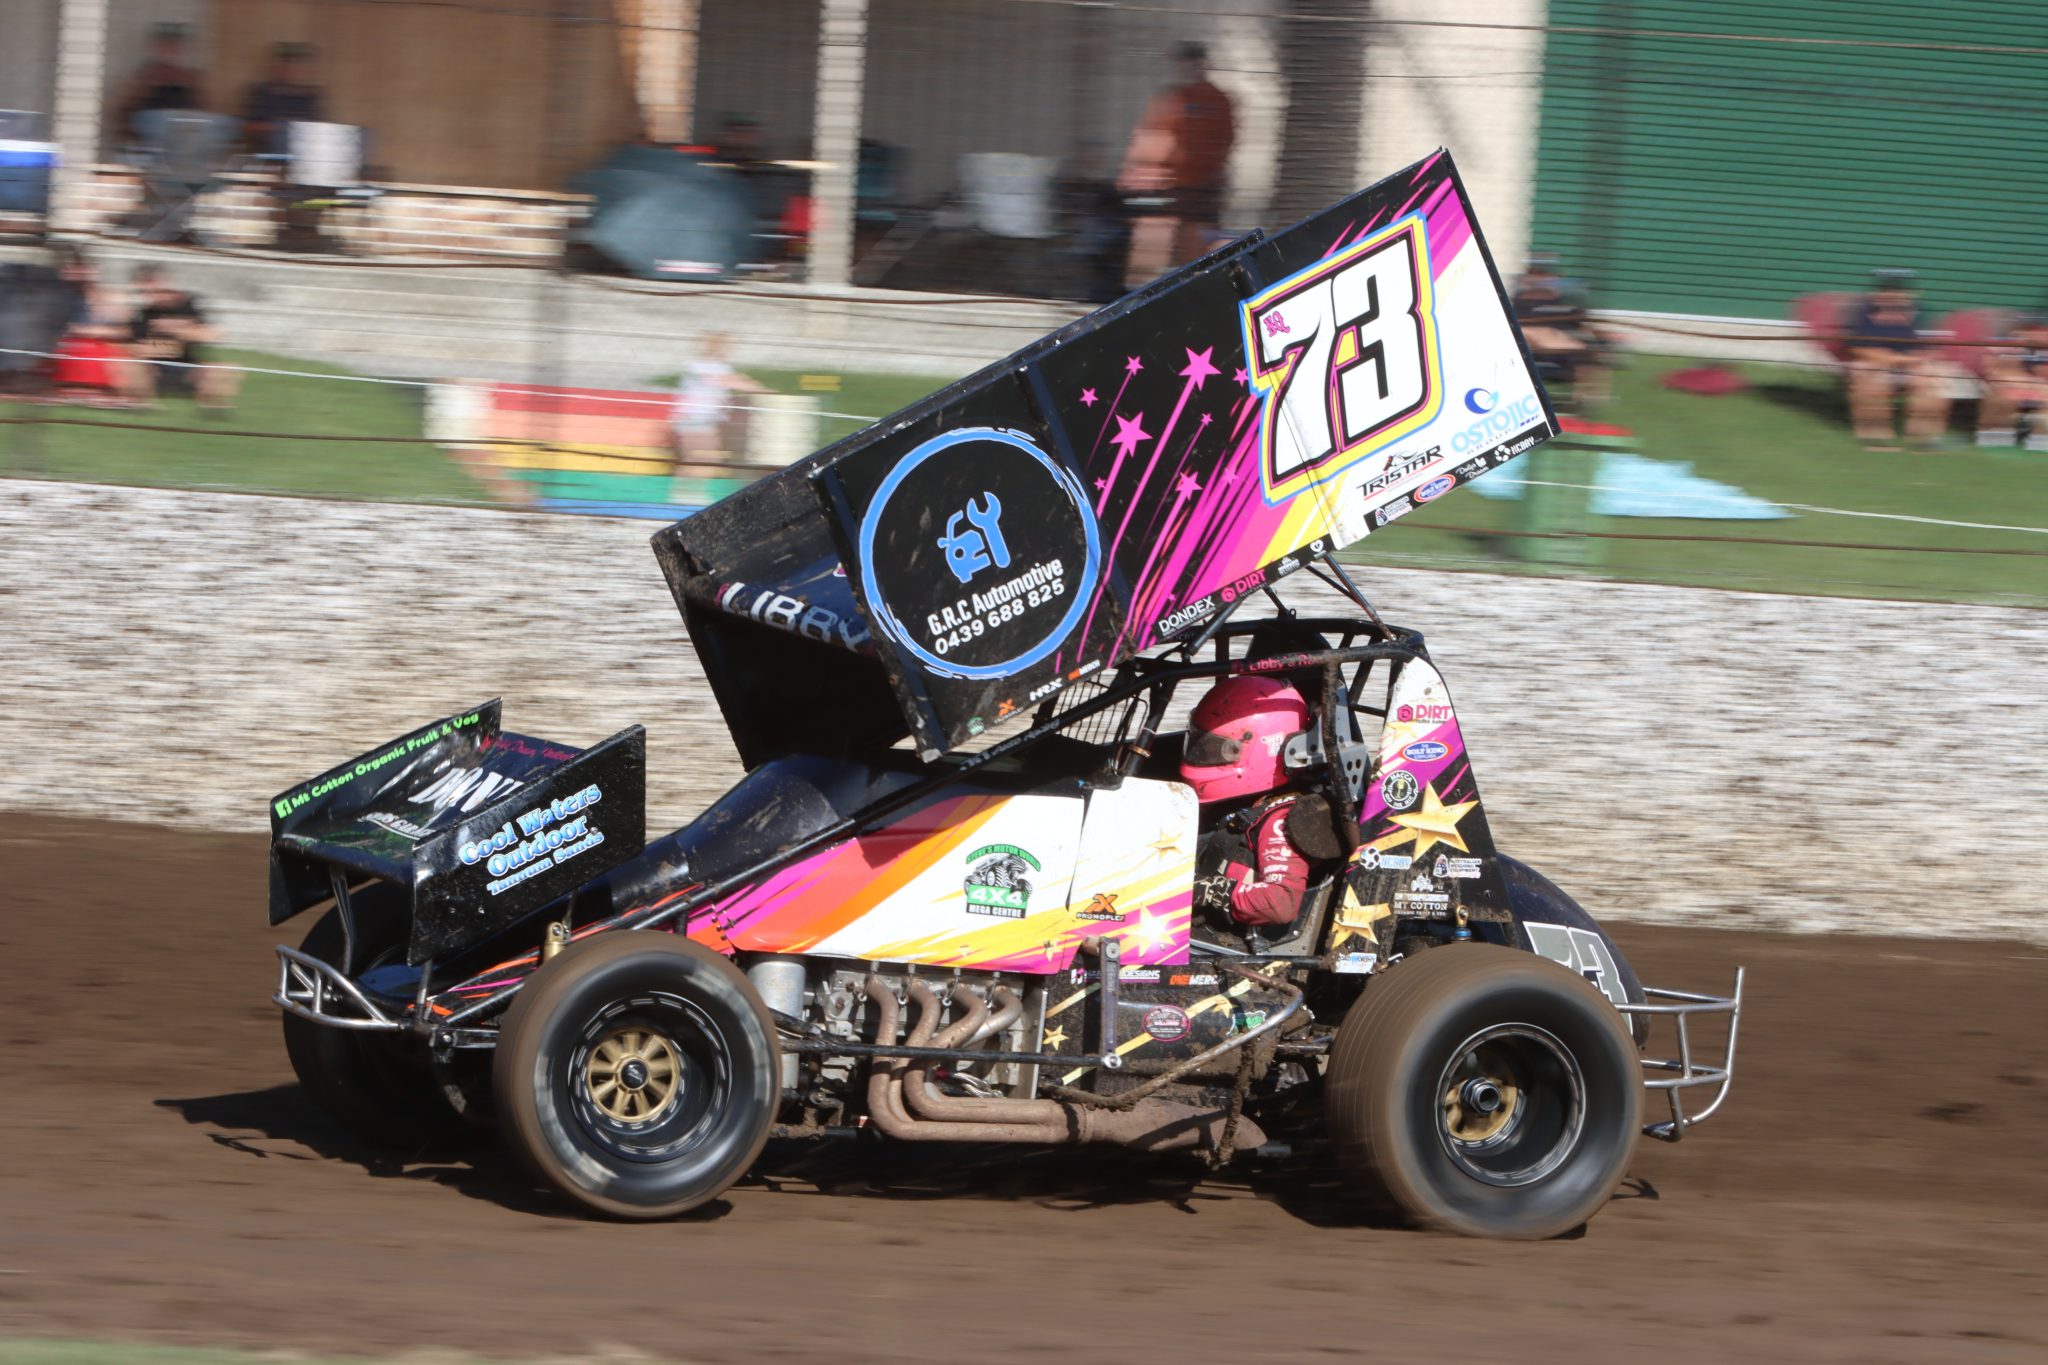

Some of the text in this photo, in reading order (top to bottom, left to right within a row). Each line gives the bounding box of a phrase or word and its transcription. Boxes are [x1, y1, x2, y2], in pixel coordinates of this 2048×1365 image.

[1252, 227, 1430, 488] 73
[1450, 394, 1540, 453] OSTOJIC
[1356, 444, 1445, 497] TRISTAR
[927, 558, 1064, 636] G.R.C Automotive
[1234, 569, 1267, 595] DIRT
[935, 578, 1065, 655] 0439 688 825
[1158, 596, 1216, 633] DONDEX
[1416, 705, 1451, 720] DIRT
[291, 712, 480, 809] Mt Cotton Organic Fruit & Veg
[1406, 747, 1445, 756] BOLT KING
[1390, 771, 1413, 783] MACCA
[458, 821, 518, 865] Cool
[515, 783, 603, 837] Waters
[487, 815, 588, 876] Outdoor
[552, 831, 605, 864] Sands
[993, 843, 1019, 855] MOTOR
[968, 903, 1022, 918] MEGA CENTRE
[969, 886, 1024, 907] 4X4
[1410, 901, 1448, 911] COTTON
